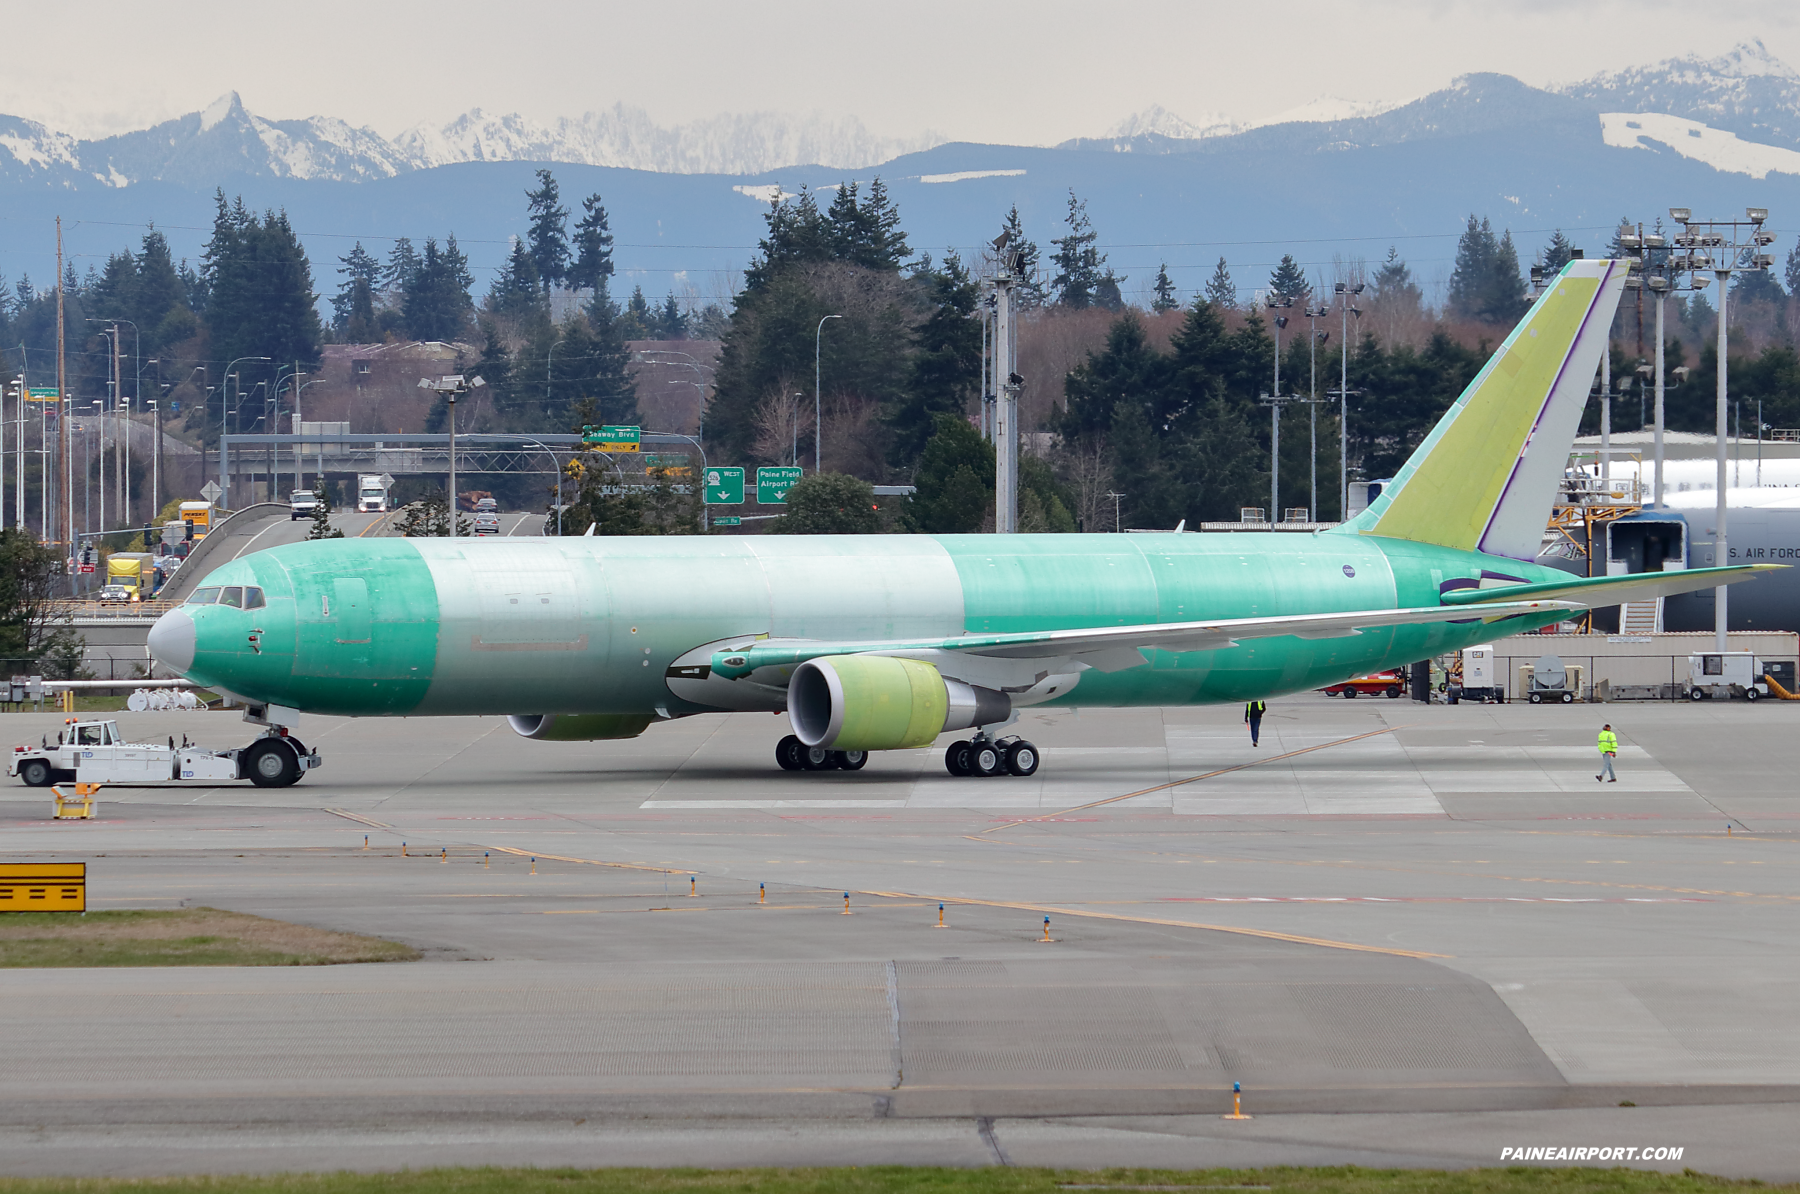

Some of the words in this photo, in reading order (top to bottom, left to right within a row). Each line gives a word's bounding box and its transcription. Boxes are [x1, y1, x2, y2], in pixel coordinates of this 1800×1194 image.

[760, 470, 780, 478] Paine
[781, 470, 800, 478] Field
[761, 480, 787, 489] Airport
[1746, 547, 1765, 558] AIR
